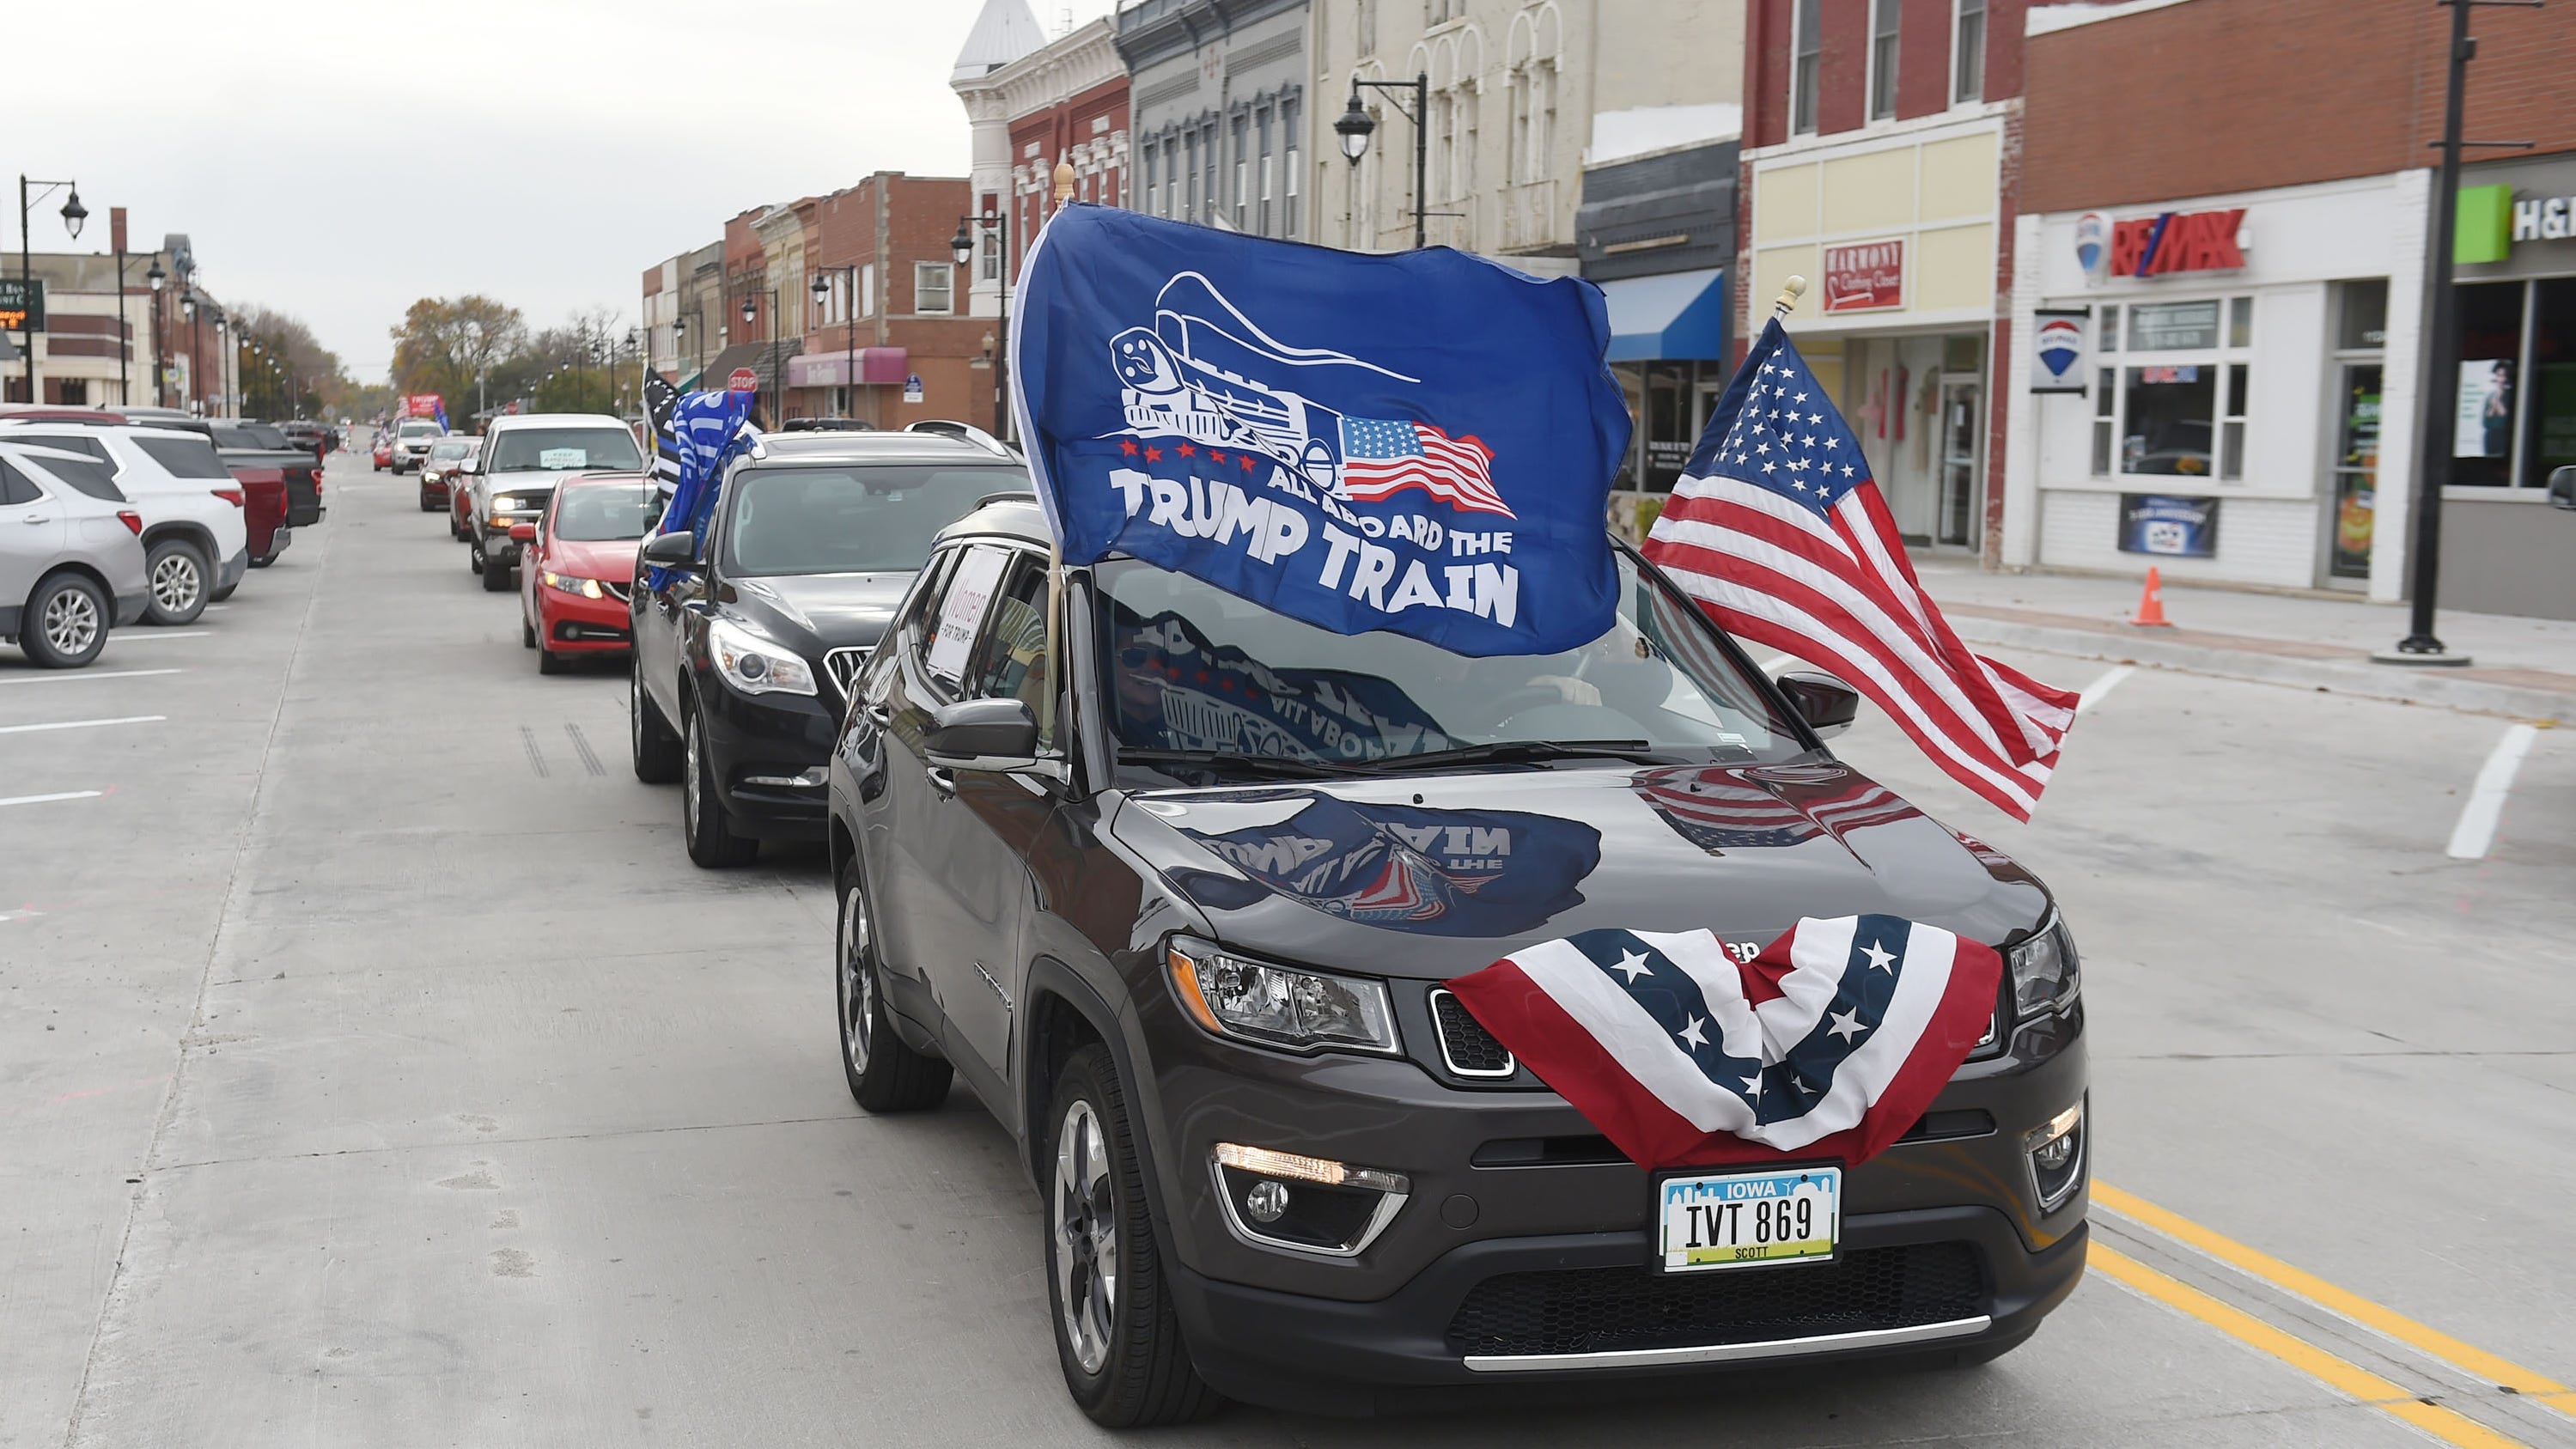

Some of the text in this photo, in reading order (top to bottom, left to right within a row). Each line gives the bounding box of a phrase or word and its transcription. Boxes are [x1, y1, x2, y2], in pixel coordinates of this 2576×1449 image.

[2513, 198, 2576, 240] H&
[1827, 242, 1898, 272] HARMONY
[2111, 209, 2247, 277] RE/MAX
[730, 376, 757, 388] STOP
[1267, 465, 1513, 557] ALL ABOARD THE
[1109, 468, 1519, 628] TRUMP TRAIN
[948, 577, 988, 625] Women
[1725, 941, 1761, 964] ep
[1726, 1181, 1776, 1199] IOWA
[1685, 1198, 1811, 1248] IVT 869
[1735, 1246, 1769, 1259] SCOTT
